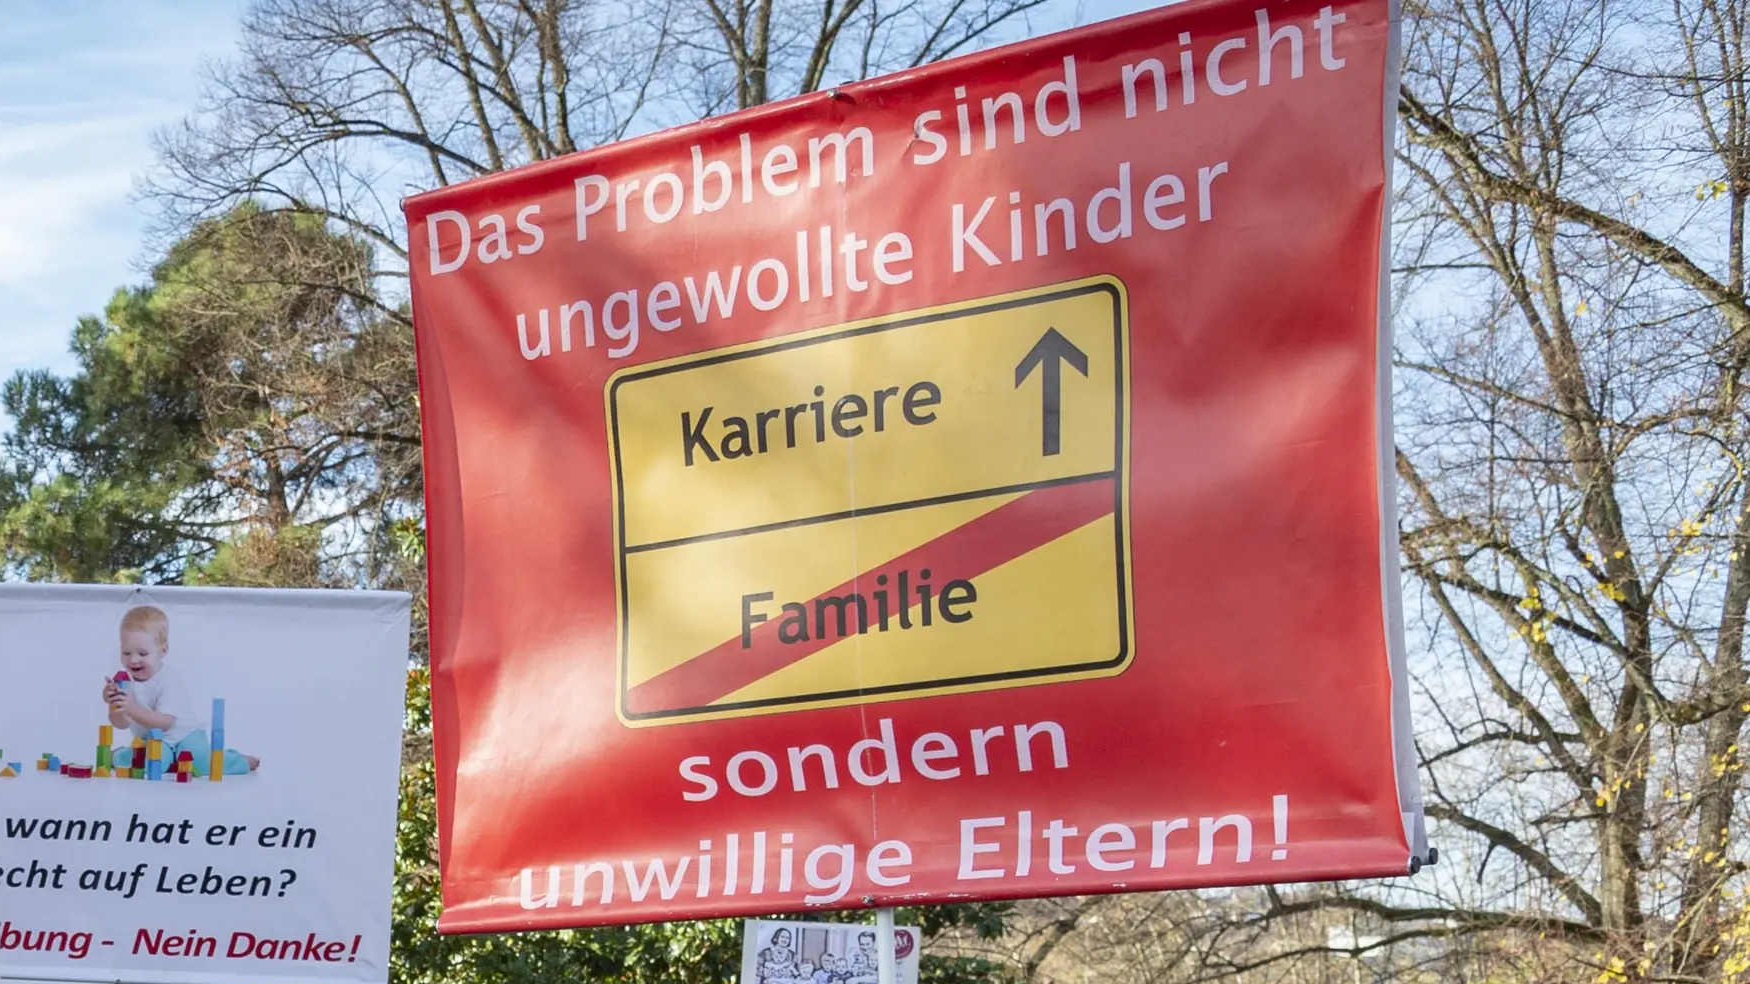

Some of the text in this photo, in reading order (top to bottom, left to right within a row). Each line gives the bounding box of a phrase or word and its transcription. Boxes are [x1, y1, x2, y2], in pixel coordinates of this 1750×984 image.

[427, 4, 1346, 275] Das Problem sind nicht
[516, 162, 1227, 361] ungewollte Kinder
[681, 382, 940, 466] Karriere
[743, 569, 979, 649] Familie
[677, 717, 1067, 801] sondern
[6, 814, 316, 848] wann hat er ein
[517, 795, 1289, 911] unwillige Eltern!
[79, 864, 147, 898] auf
[156, 866, 296, 897] Leben?
[0, 921, 92, 959] bung
[132, 928, 217, 957] Nein
[227, 932, 361, 962] Danke!
